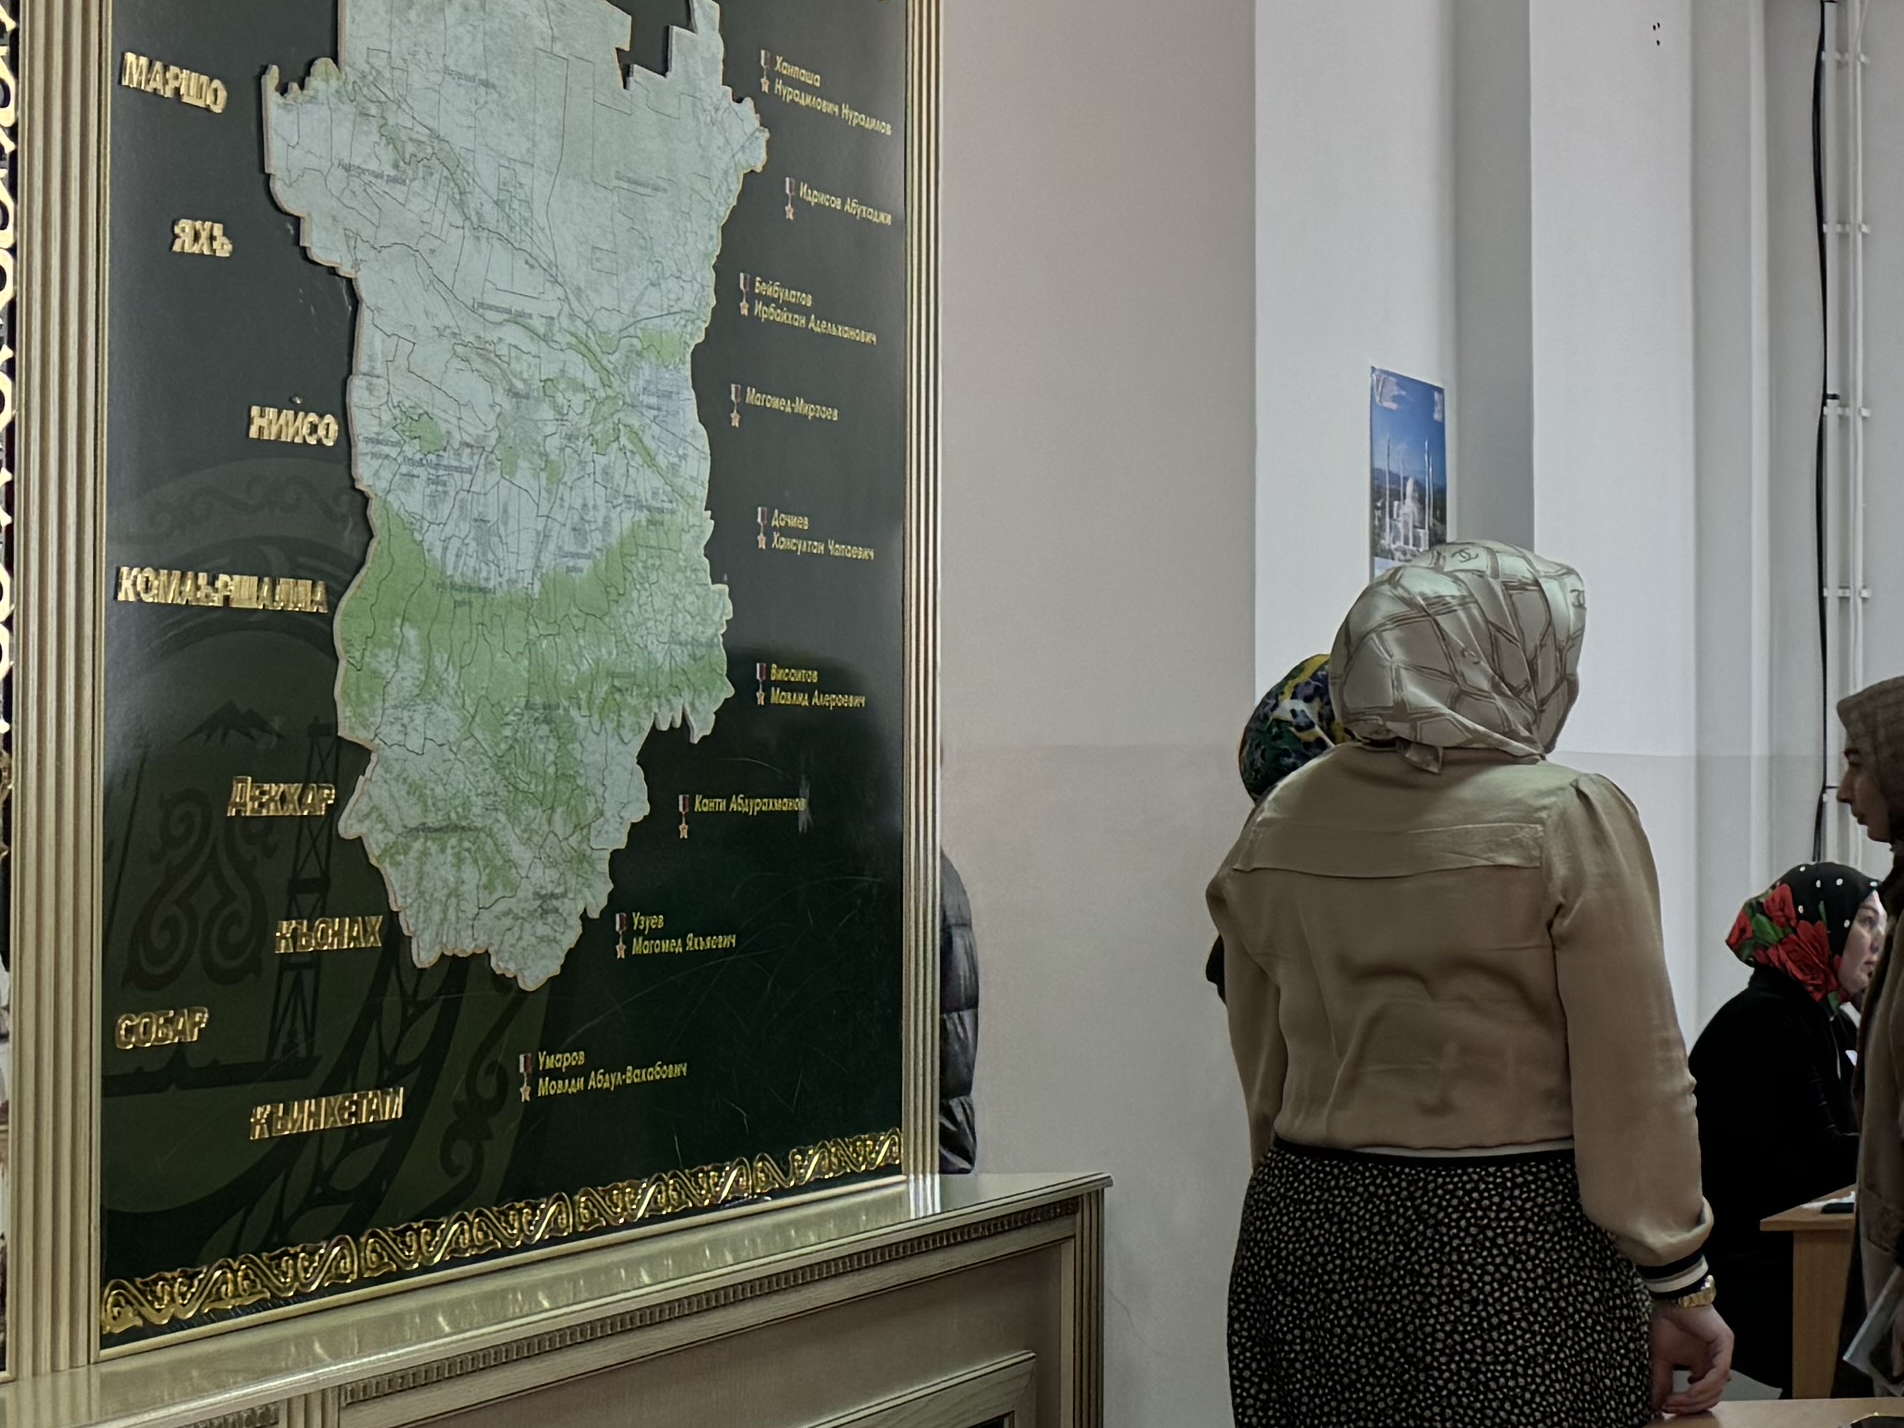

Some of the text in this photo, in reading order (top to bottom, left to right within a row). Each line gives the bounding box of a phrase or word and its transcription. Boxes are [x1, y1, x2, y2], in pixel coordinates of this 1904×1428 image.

[121, 51, 228, 114] МАРШО
[774, 55, 821, 87] Ханпаша
[800, 181, 841, 211] Идрисов
[171, 218, 233, 257] ЯХЬ
[754, 276, 813, 307] Бейбулатов
[249, 395, 339, 446] НИЙСО
[227, 775, 336, 816] ДЕКХАР
[694, 794, 726, 812] Канти
[275, 915, 383, 954] КЪОНАХ
[631, 912, 664, 934] Узуев
[631, 936, 683, 955] Магомед
[115, 1006, 209, 1050] СОБАР
[537, 1050, 585, 1072] Умаров
